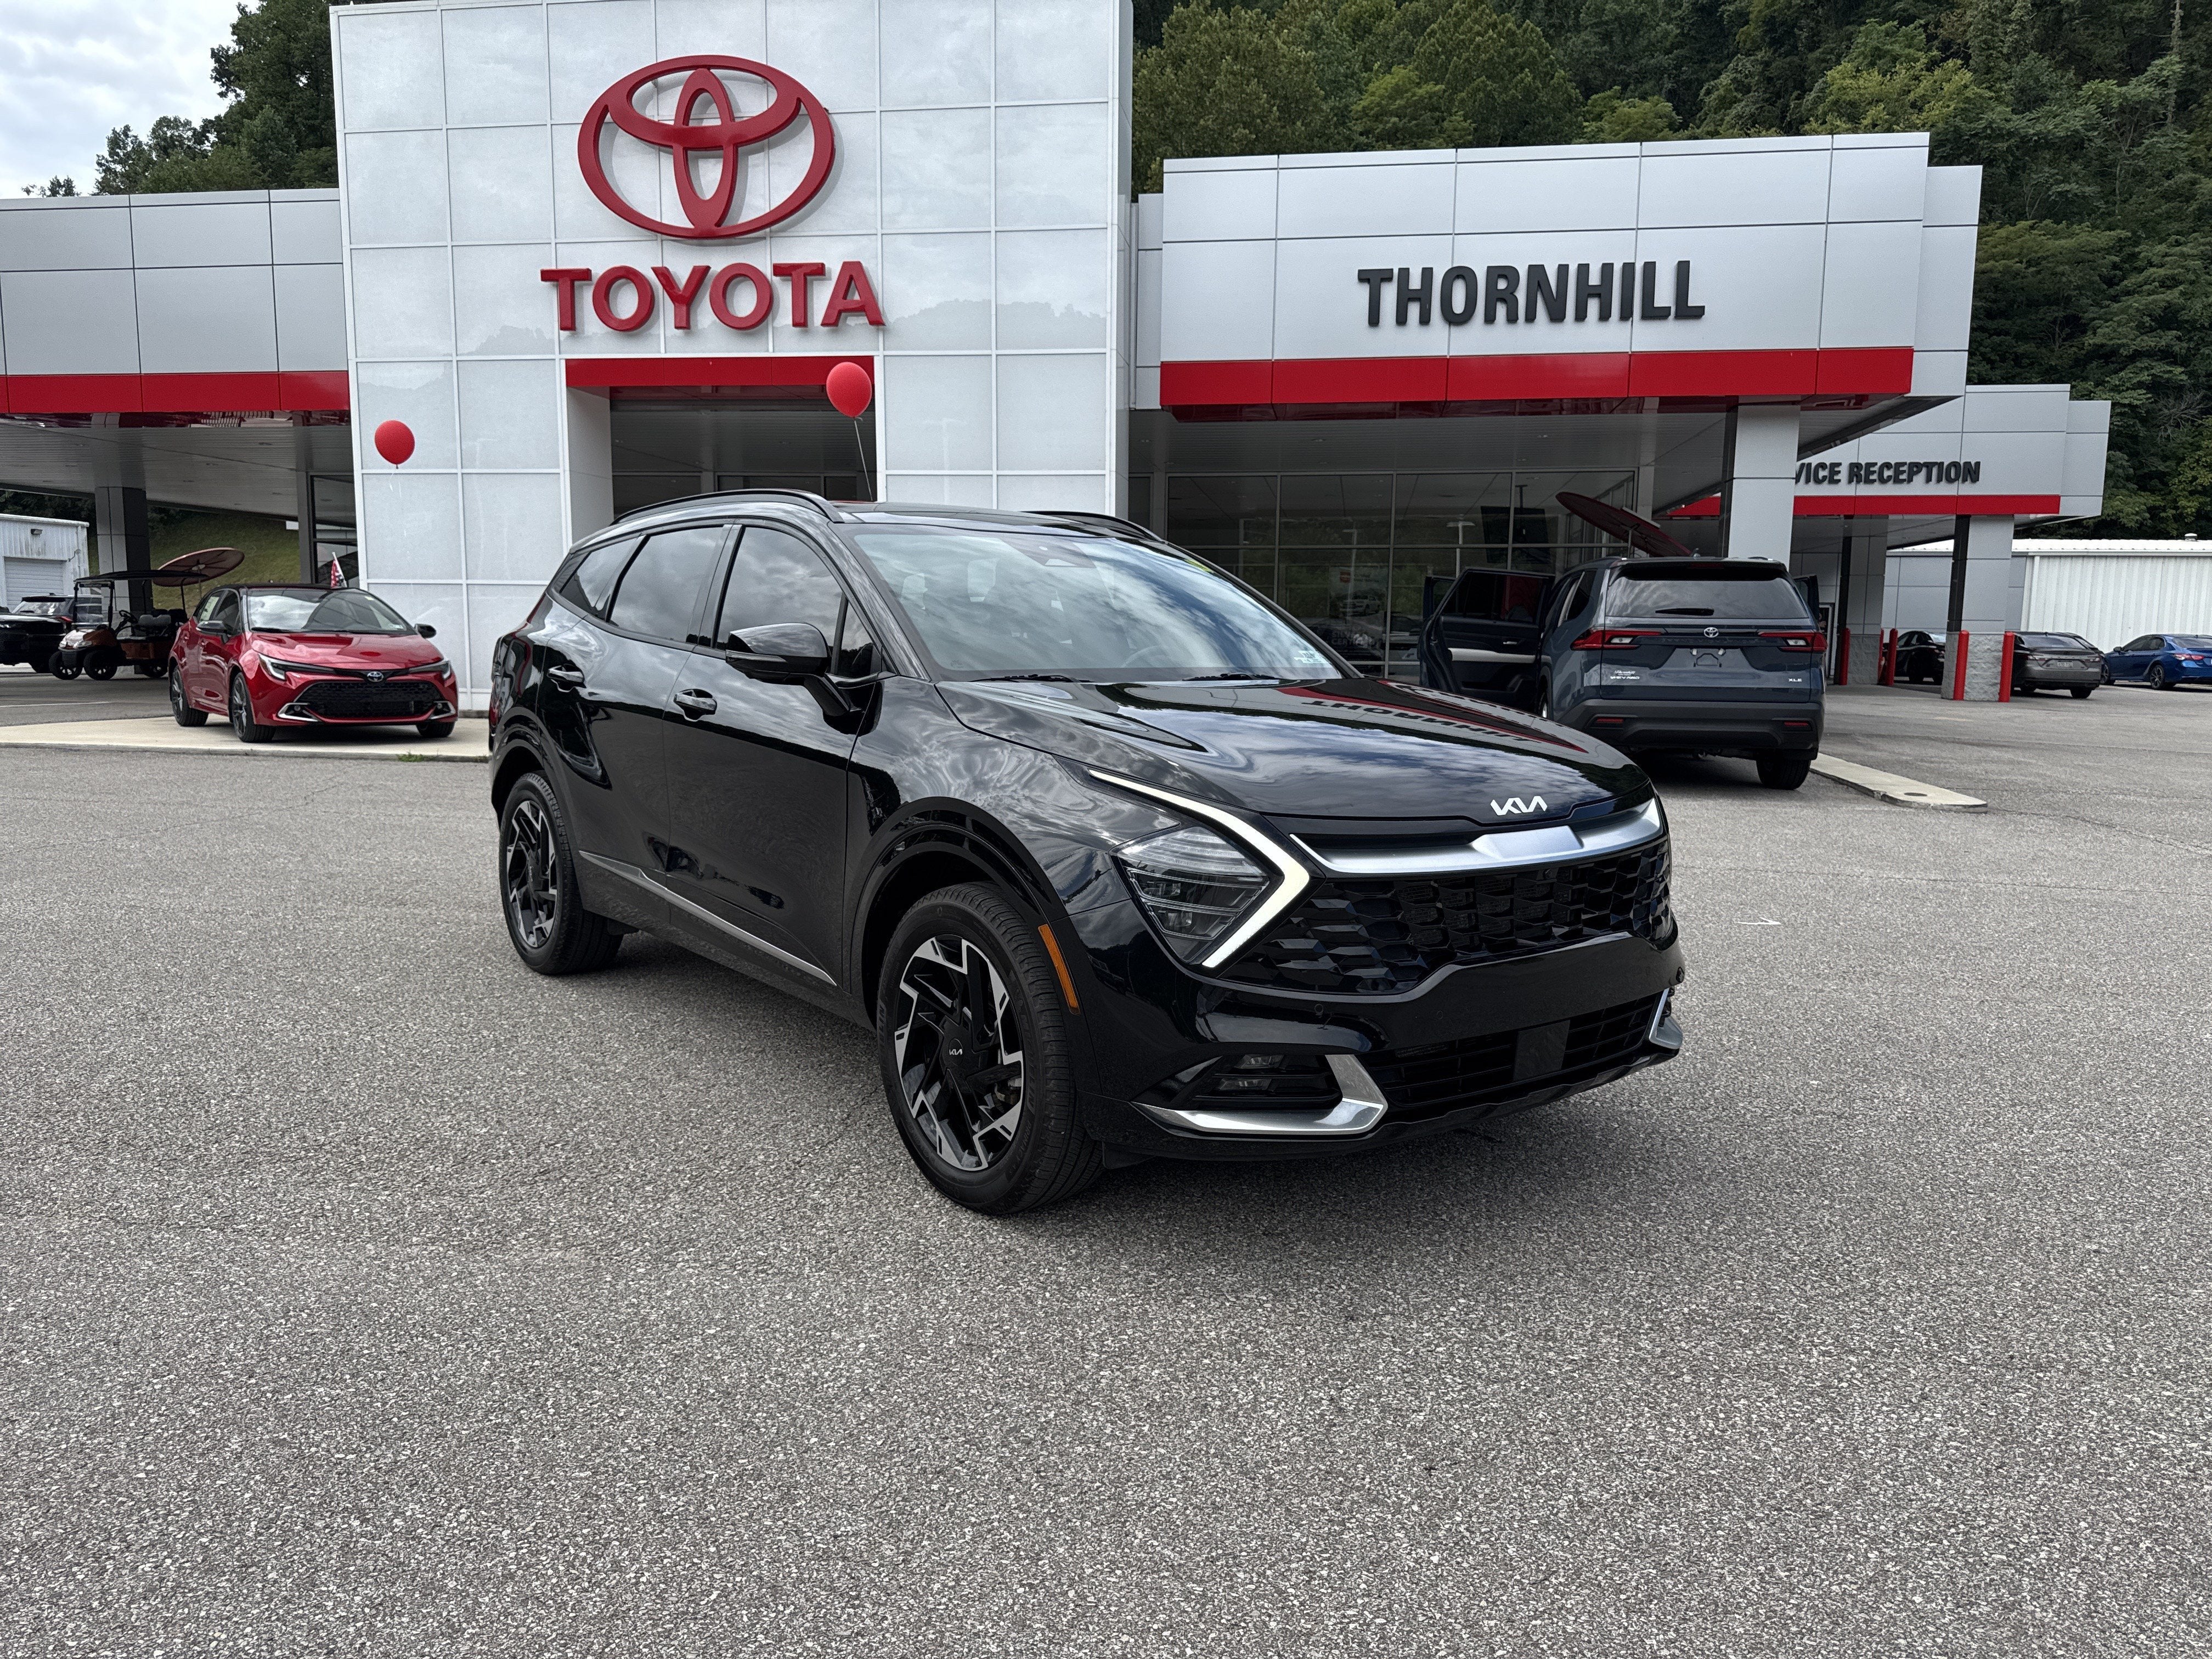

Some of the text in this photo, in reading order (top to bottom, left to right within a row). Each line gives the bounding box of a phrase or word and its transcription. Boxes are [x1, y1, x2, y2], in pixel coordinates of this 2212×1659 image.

[540, 261, 885, 331] TOYOTA
[1357, 260, 1705, 326] THORNHILL
[1847, 461, 1981, 484] RECEPTION
[1490, 795, 1548, 816] KIA
